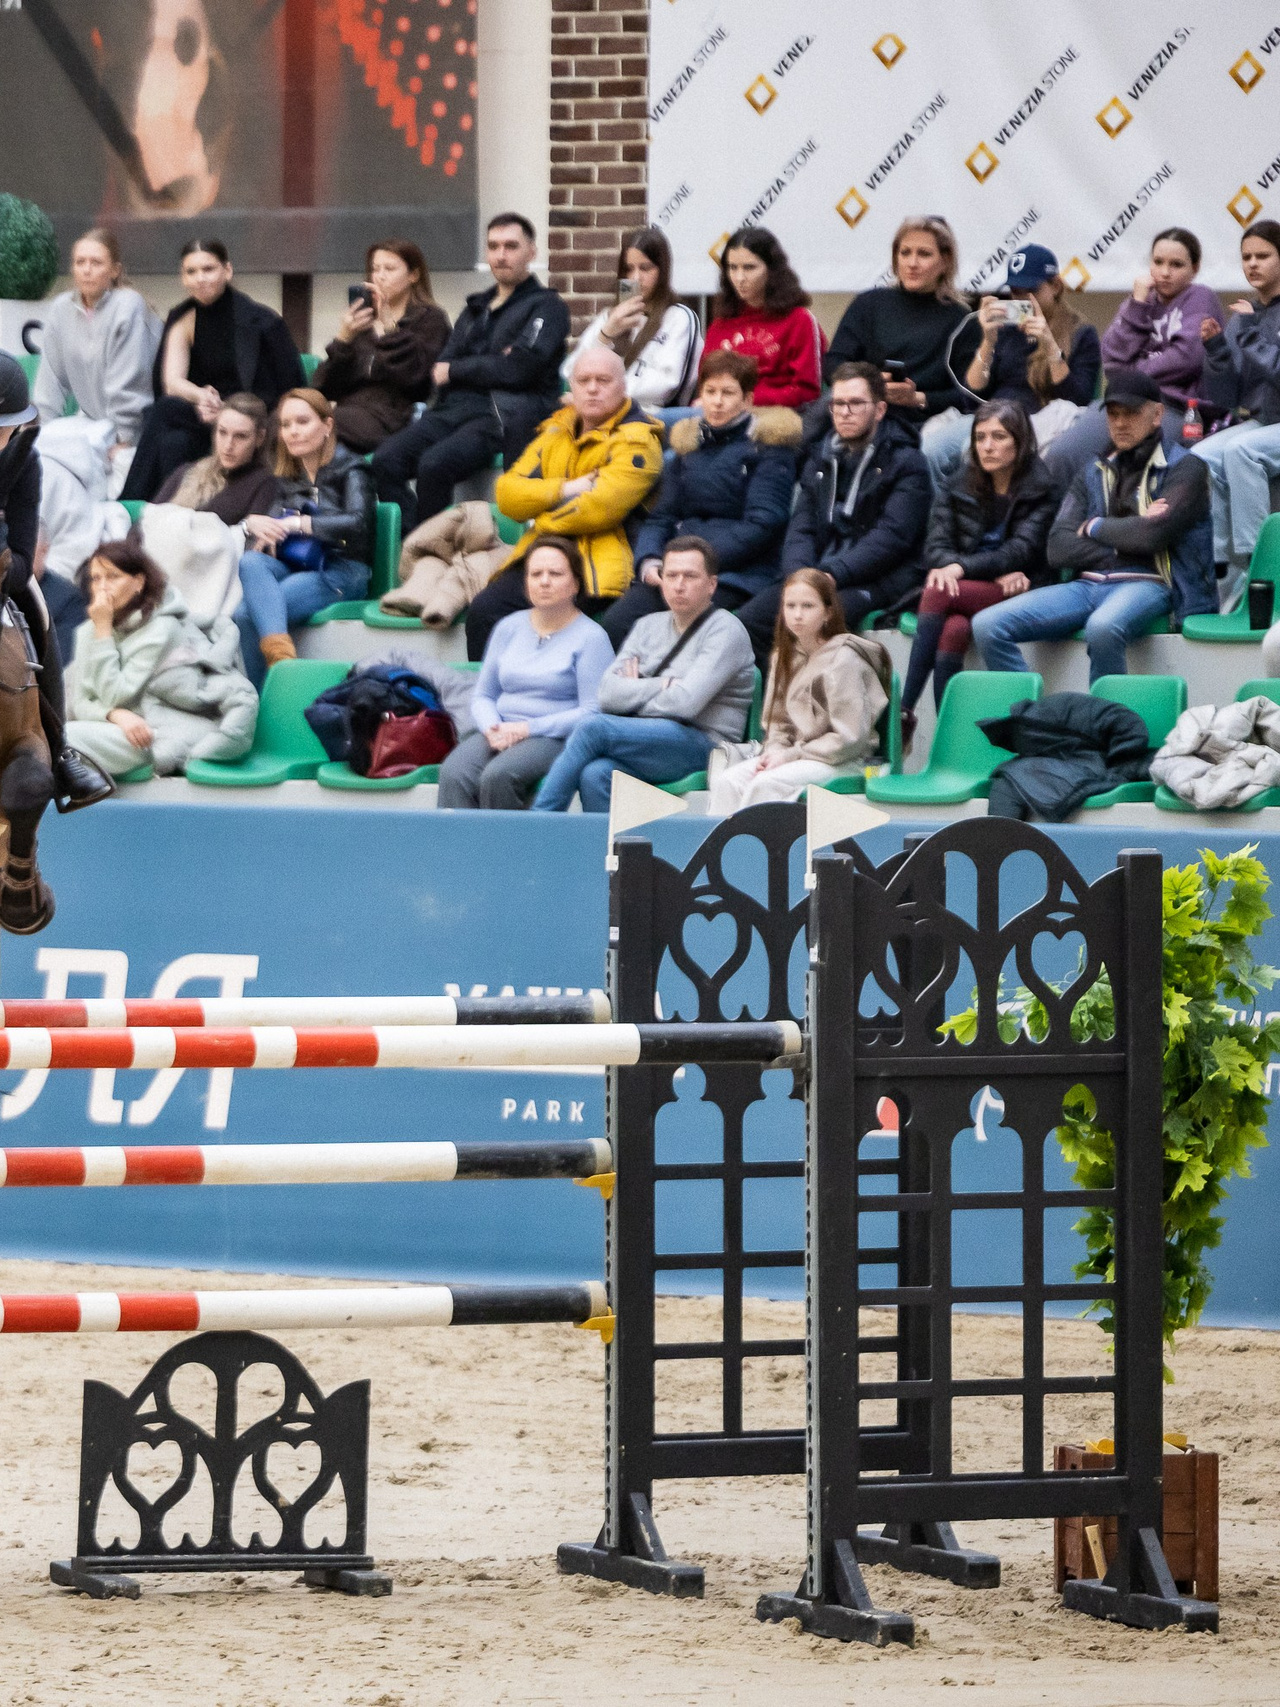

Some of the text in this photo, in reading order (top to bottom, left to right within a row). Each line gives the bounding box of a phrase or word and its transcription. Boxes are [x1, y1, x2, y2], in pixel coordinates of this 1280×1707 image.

[650, 64, 697, 123] VENEZIA
[993, 44, 1081, 147] VENEZIA STONE
[1127, 40, 1179, 101] VENEZIA
[864, 89, 950, 191] VENEZIA STONE
[1087, 161, 1177, 262] VENEZIA STONE
[502, 1097, 585, 1123] PARK
